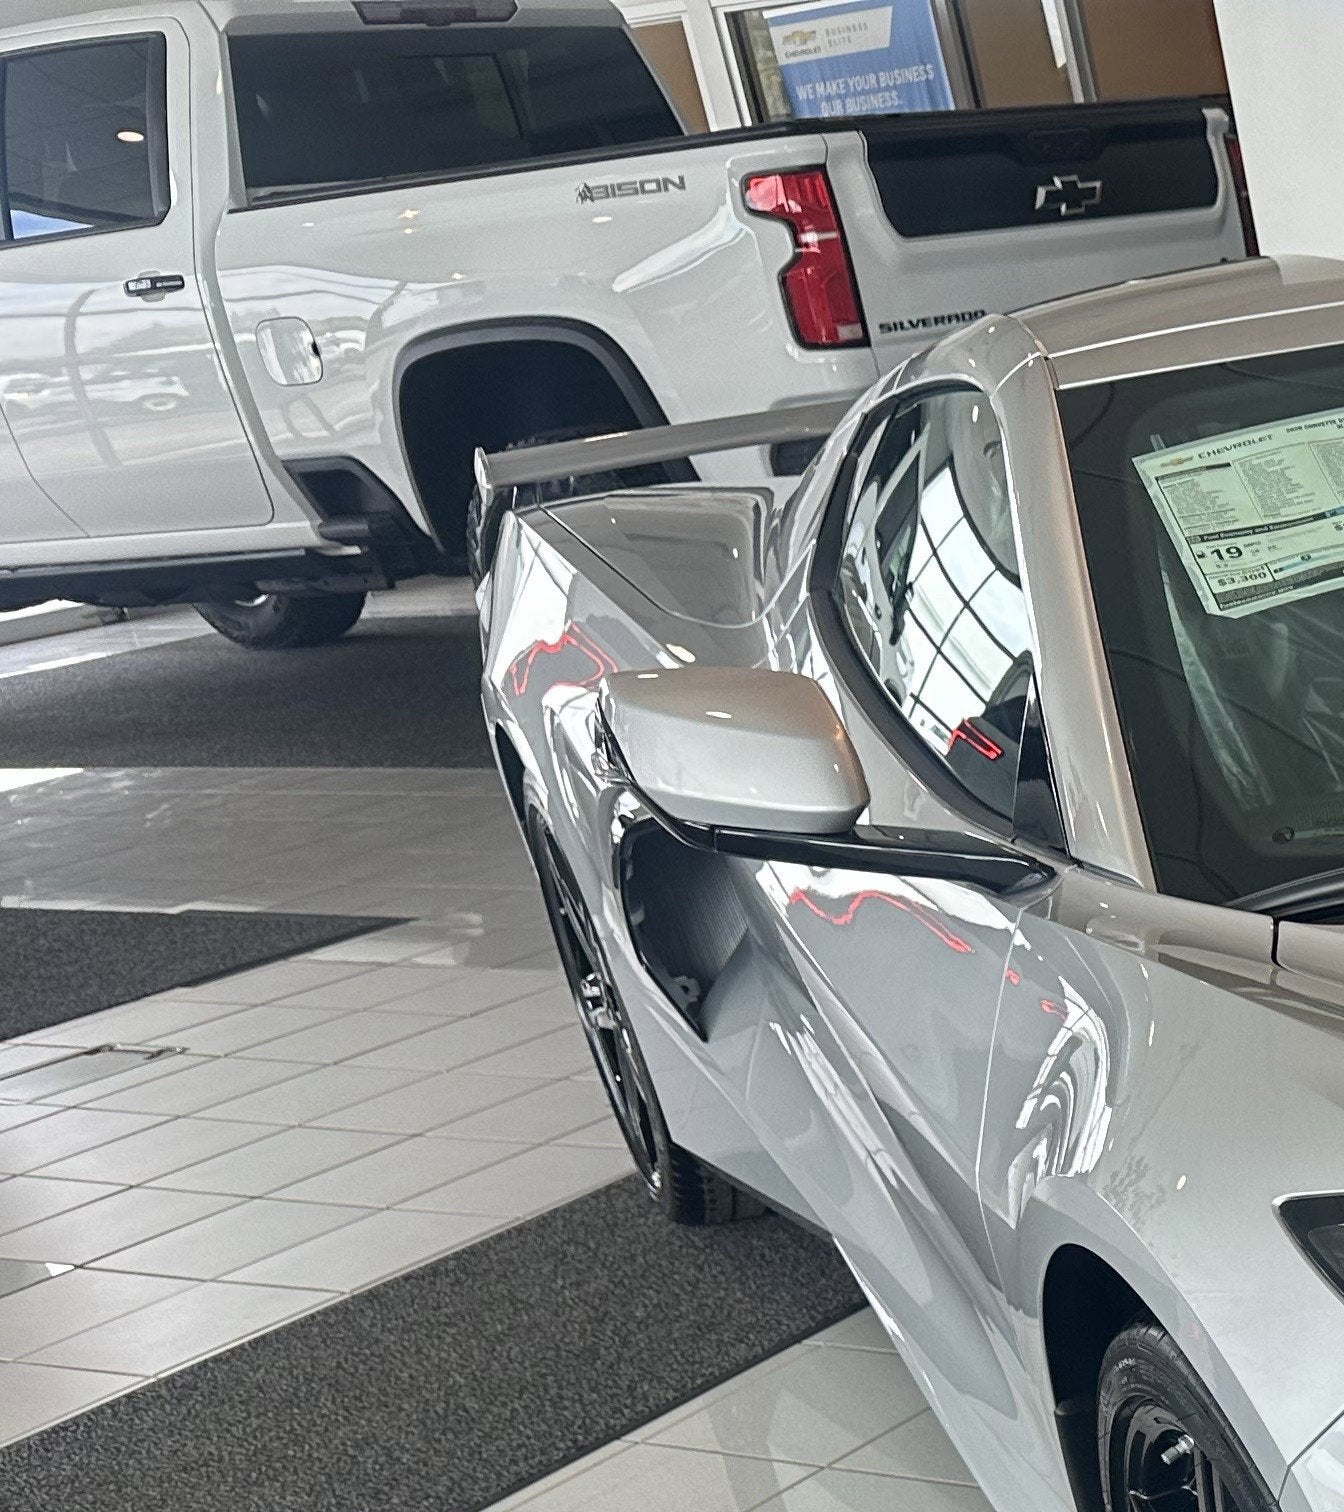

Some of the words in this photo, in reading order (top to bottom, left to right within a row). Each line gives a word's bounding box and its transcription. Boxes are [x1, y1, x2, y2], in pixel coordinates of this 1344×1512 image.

[796, 84, 814, 100] WE
[815, 79, 846, 97] MAKE
[847, 73, 878, 92] YOUR
[879, 64, 934, 87] BUSINESS
[820, 98, 844, 117] OUR
[591, 175, 686, 201] BISON
[879, 309, 986, 333] SILVERADO
[1197, 434, 1273, 459] CHEVROLET
[1210, 545, 1243, 561] 19
